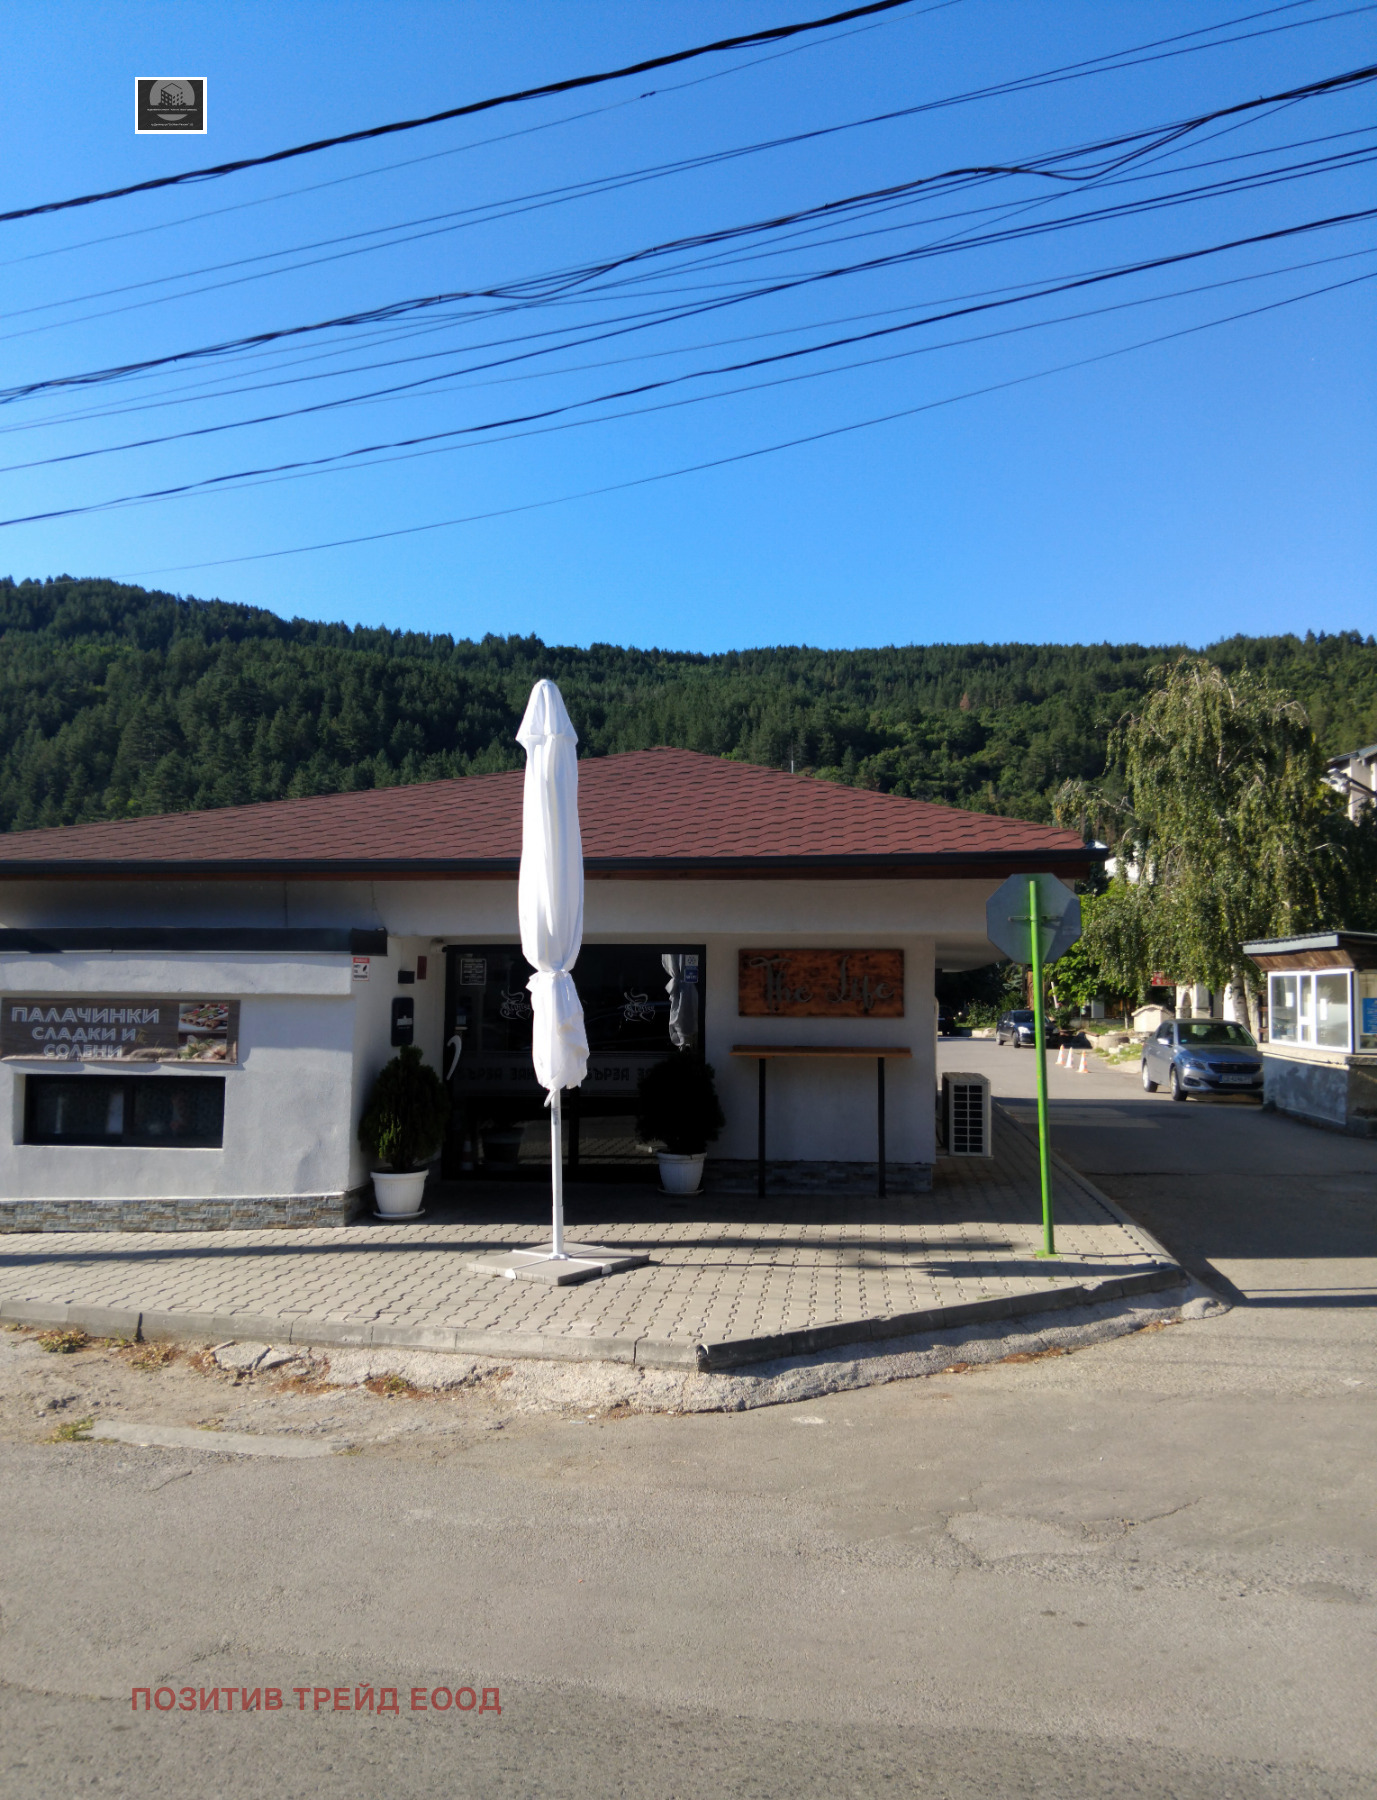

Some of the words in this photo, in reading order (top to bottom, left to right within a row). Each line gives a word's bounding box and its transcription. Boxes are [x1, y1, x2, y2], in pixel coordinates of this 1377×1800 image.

[750, 957, 813, 1014] The
[826, 955, 894, 1010] Life
[11, 1006, 160, 1024] ПАЛАЧИНКИ
[31, 1026, 117, 1043] СЛАДКИ
[121, 1027, 137, 1042] И
[43, 1043, 123, 1059] СОЛЕНИ
